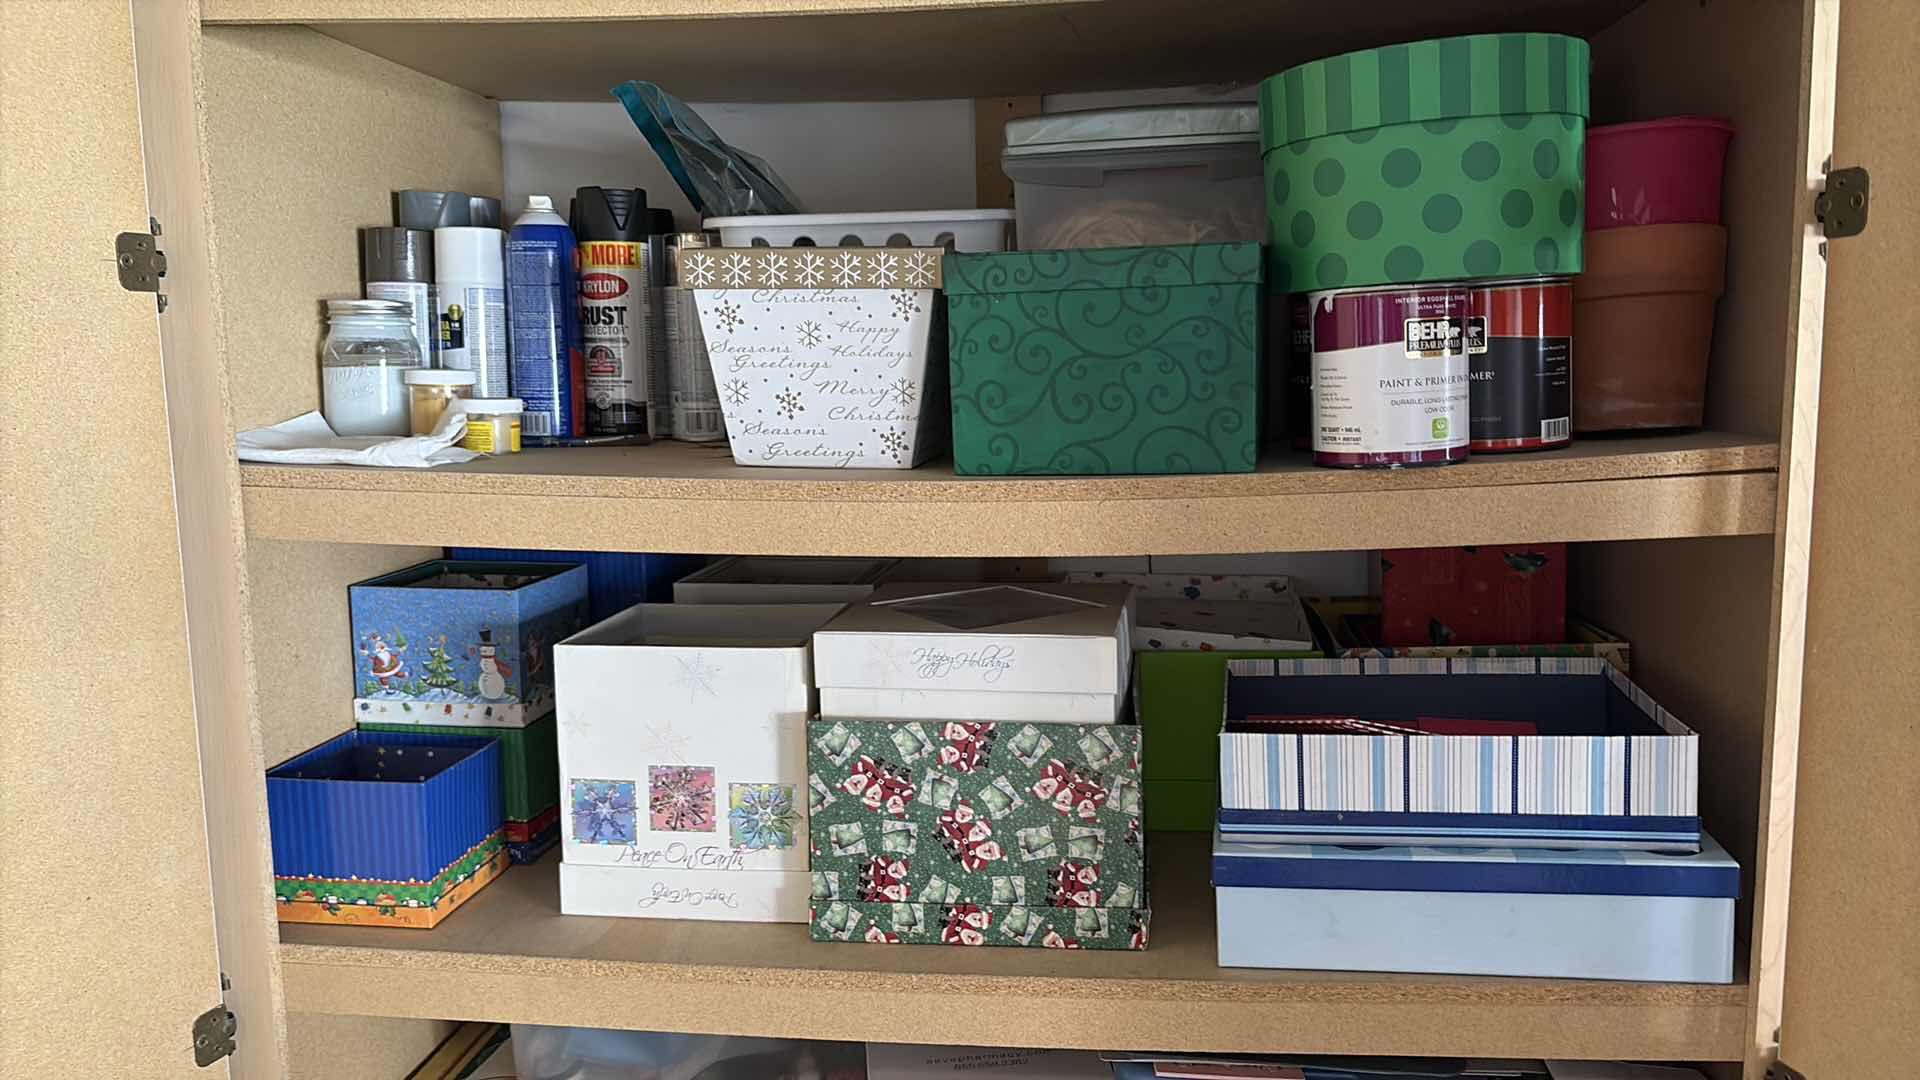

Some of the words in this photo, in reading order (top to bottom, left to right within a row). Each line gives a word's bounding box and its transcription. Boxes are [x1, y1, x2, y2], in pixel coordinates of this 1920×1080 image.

[591, 244, 635, 266] MORE
[582, 280, 620, 293] KRYLON
[751, 288, 860, 304] Christmas
[1395, 296, 1426, 305] INTERIOR
[581, 306, 628, 325] RUST
[836, 319, 901, 343] Happy
[1408, 321, 1450, 341] BEHR
[828, 344, 914, 368] Holidays
[728, 354, 833, 381] Greetings
[813, 379, 892, 407] Merry
[1379, 379, 1411, 389] PAINT
[1414, 378, 1422, 387] &
[761, 441, 867, 469] Greetings
[695, 845, 766, 871] Earth
